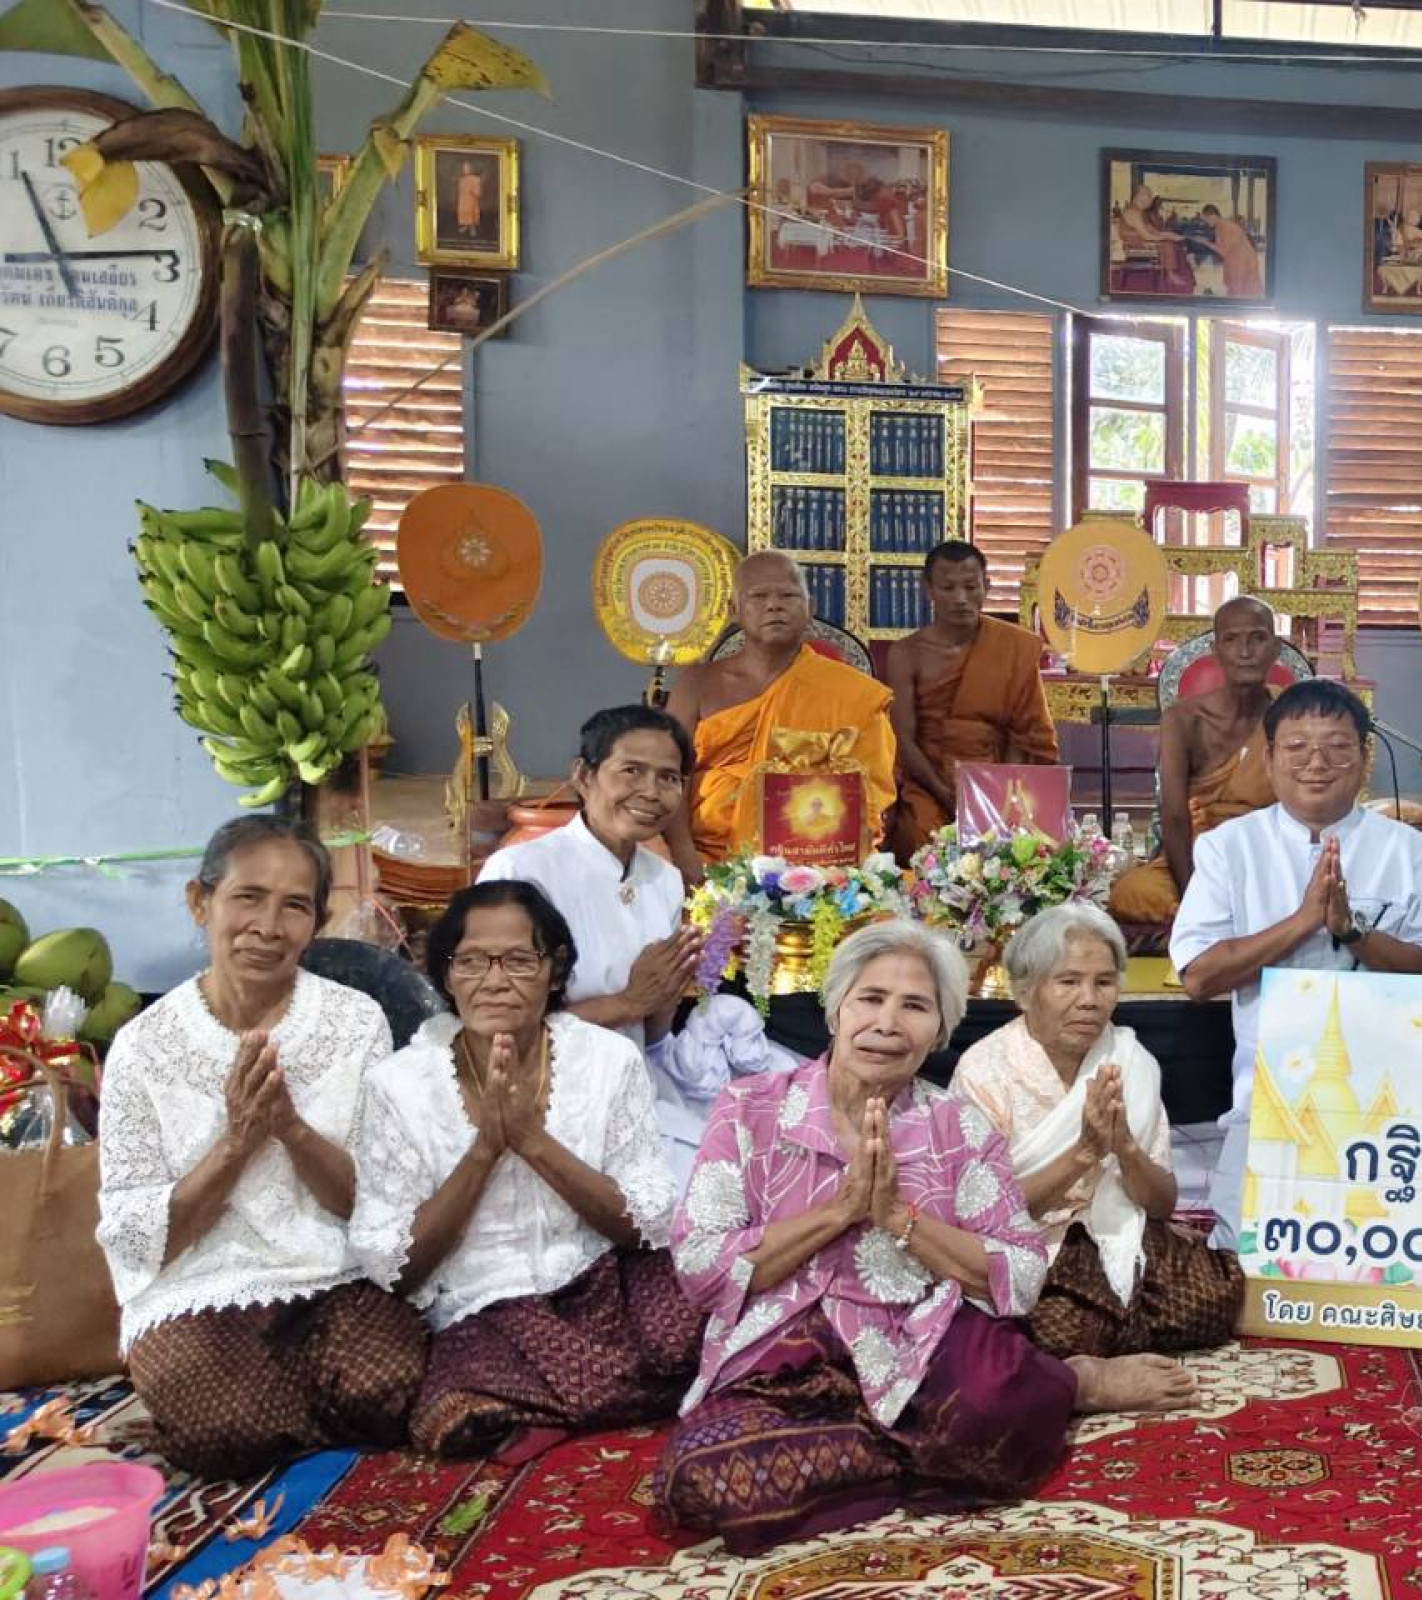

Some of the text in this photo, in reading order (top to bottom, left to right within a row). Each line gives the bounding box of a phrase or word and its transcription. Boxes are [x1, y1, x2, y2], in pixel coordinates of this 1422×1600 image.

[138, 197, 168, 232] 2
[153, 250, 181, 283] 3
[132, 299, 161, 332] 4
[42, 345, 71, 377] 6
[95, 335, 126, 368] 5
[1265, 1294, 1312, 1323] โดย
